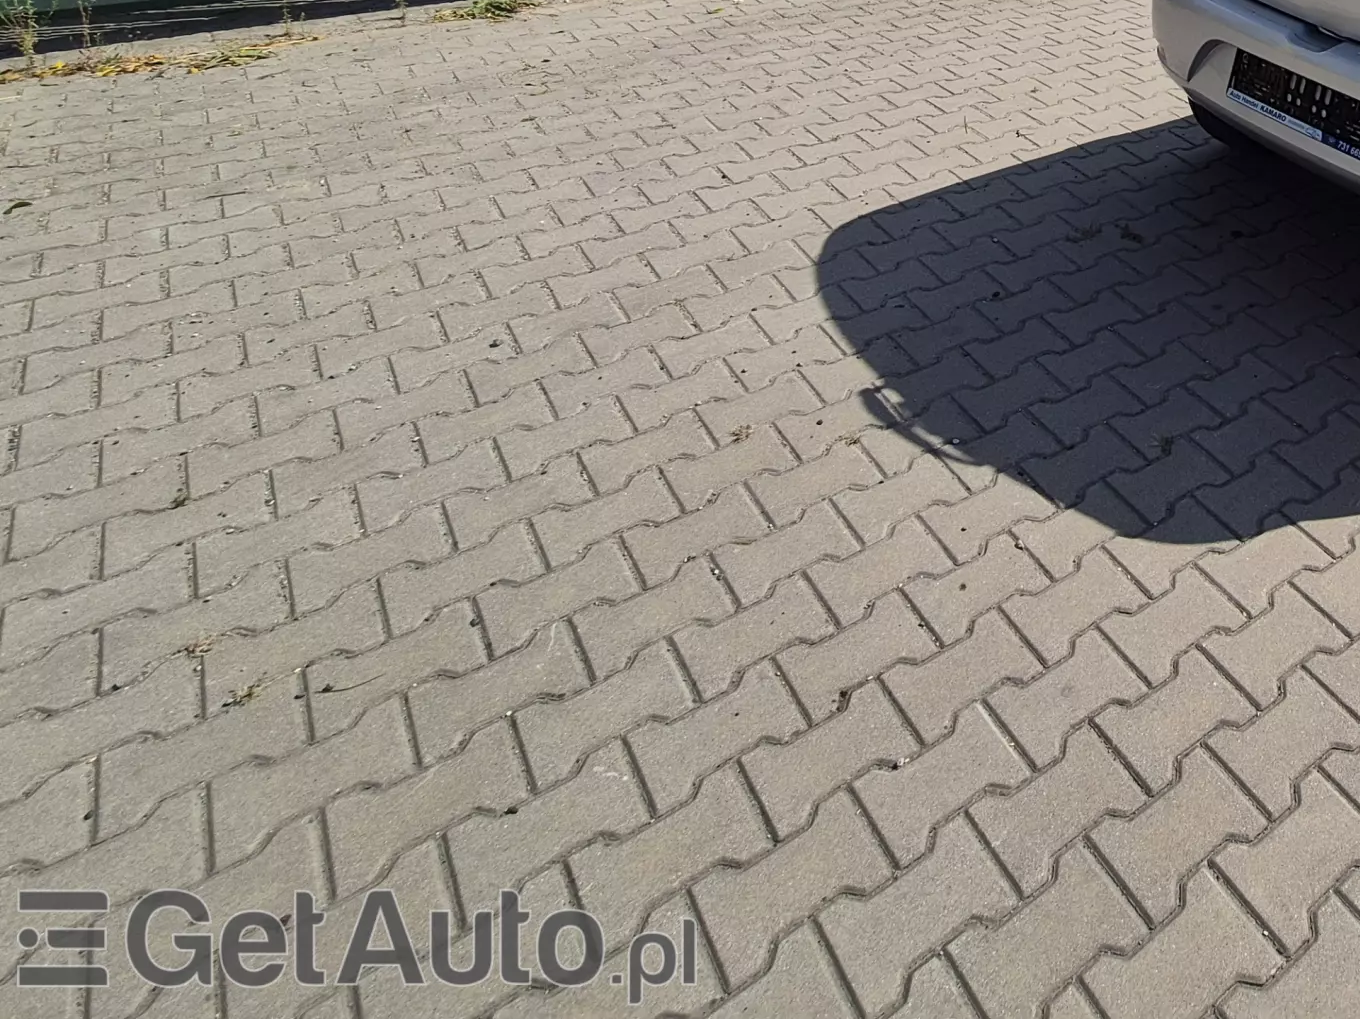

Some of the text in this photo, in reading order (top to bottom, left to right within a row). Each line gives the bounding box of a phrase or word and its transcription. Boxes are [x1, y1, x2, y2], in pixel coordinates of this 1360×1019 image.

[1229, 90, 1241, 100] Auto
[1241, 94, 1259, 109] Handel
[1259, 104, 1287, 123] KAMARO
[1337, 140, 1350, 153] 731
